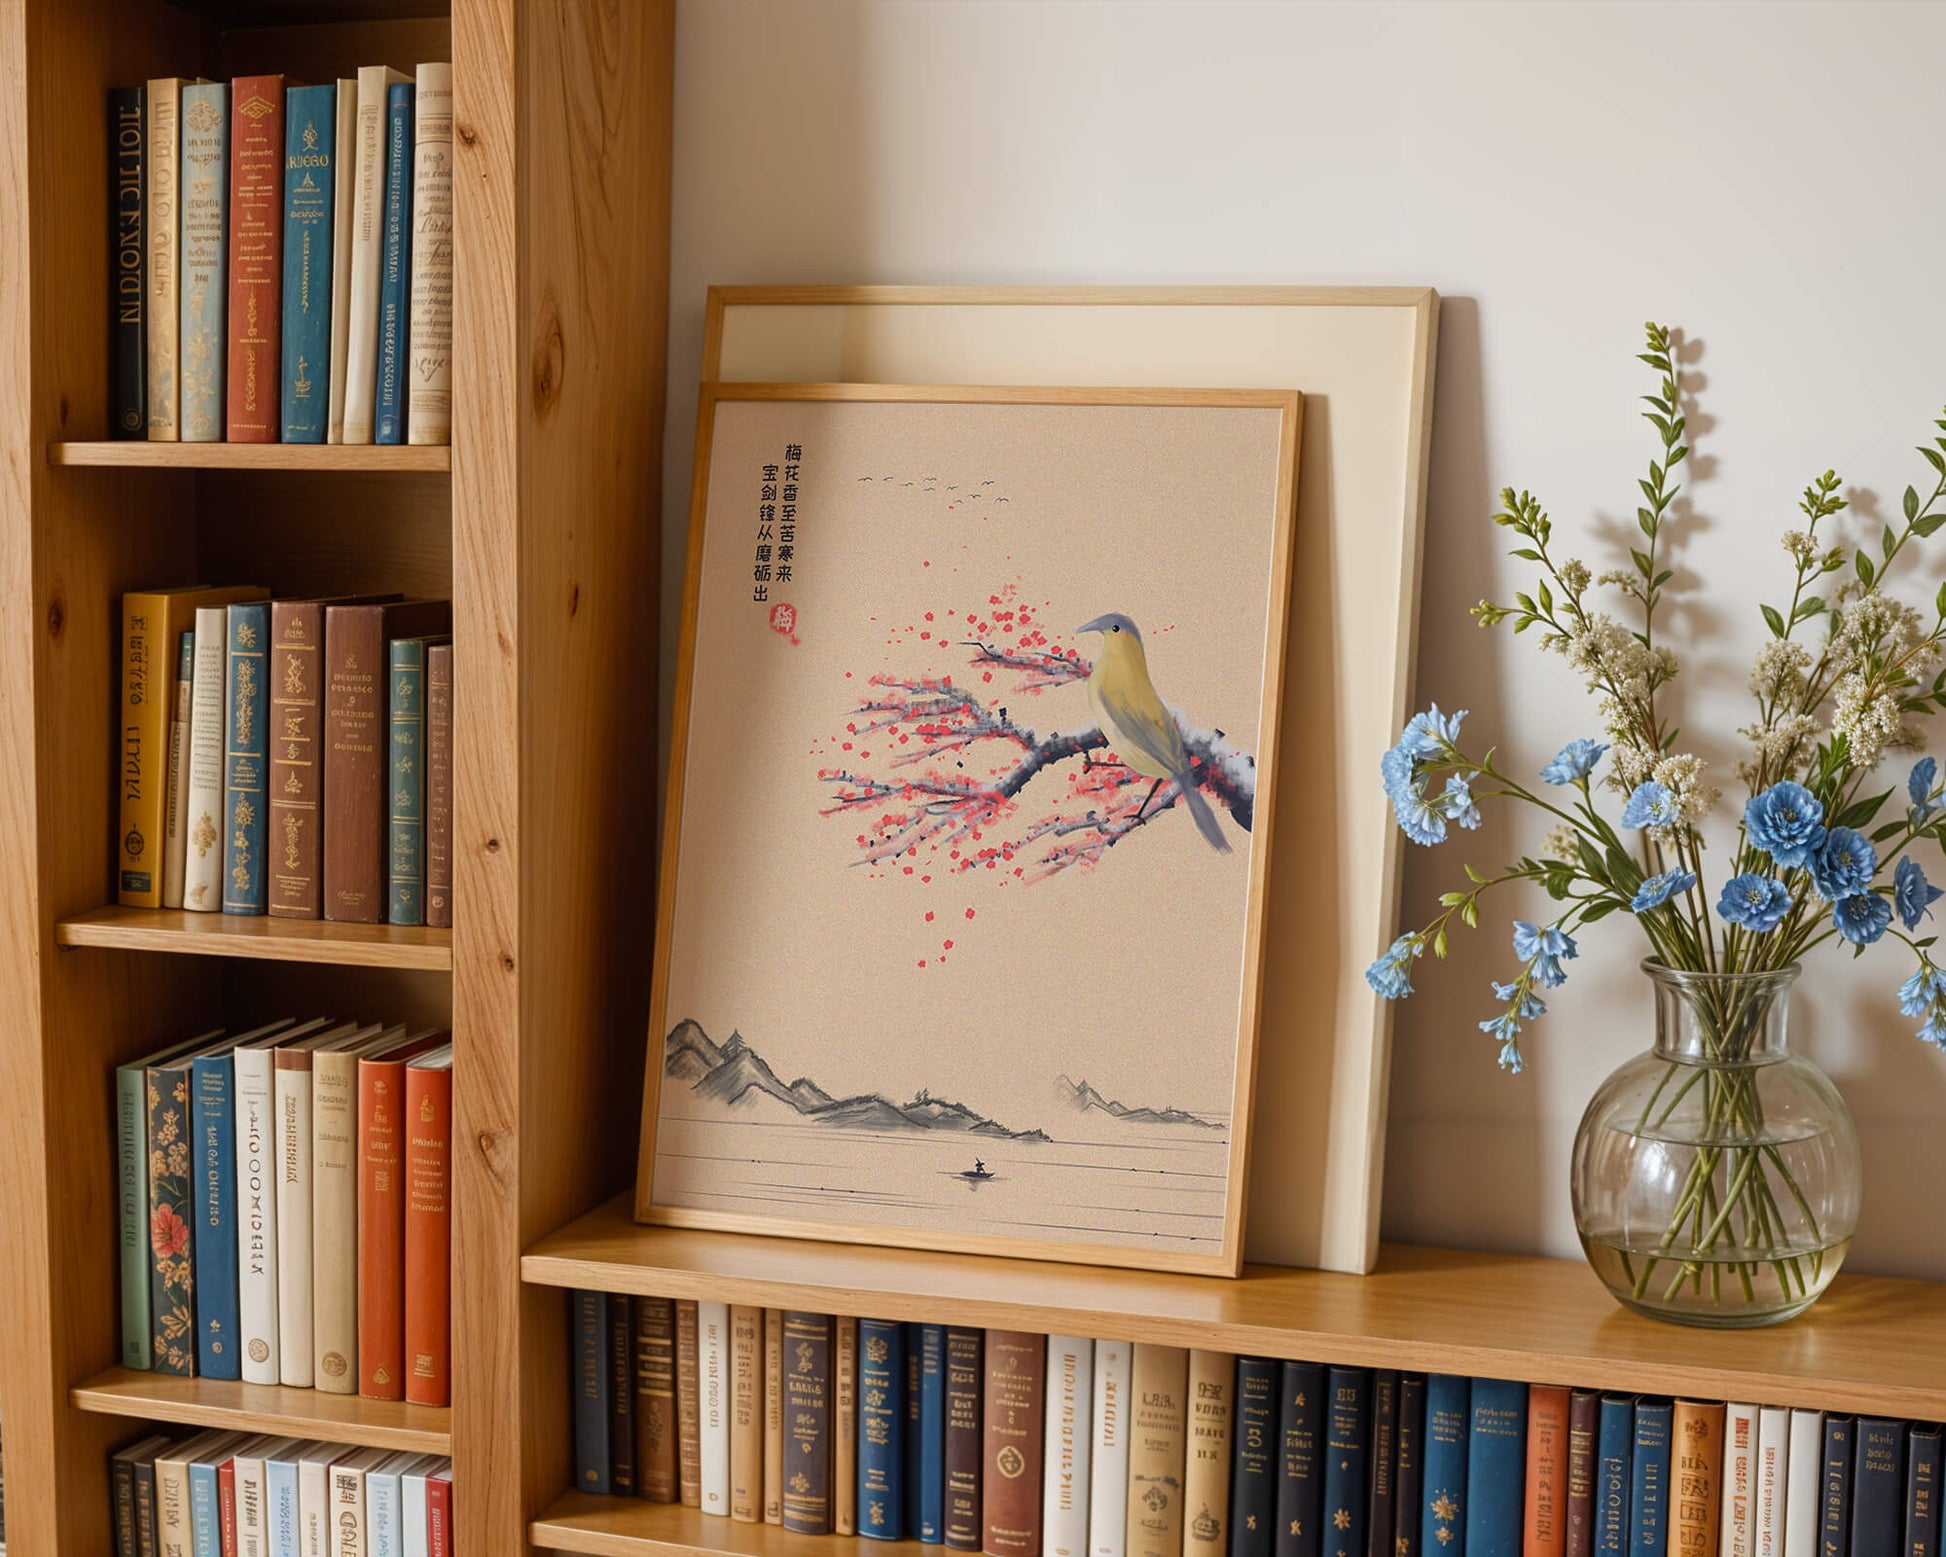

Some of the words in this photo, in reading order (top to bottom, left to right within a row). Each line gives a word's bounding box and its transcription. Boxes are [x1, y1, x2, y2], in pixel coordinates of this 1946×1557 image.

[753, 464, 779, 602] 宝剑锋从磨砺出
[776, 444, 802, 582] 梅花香至苦寒来
